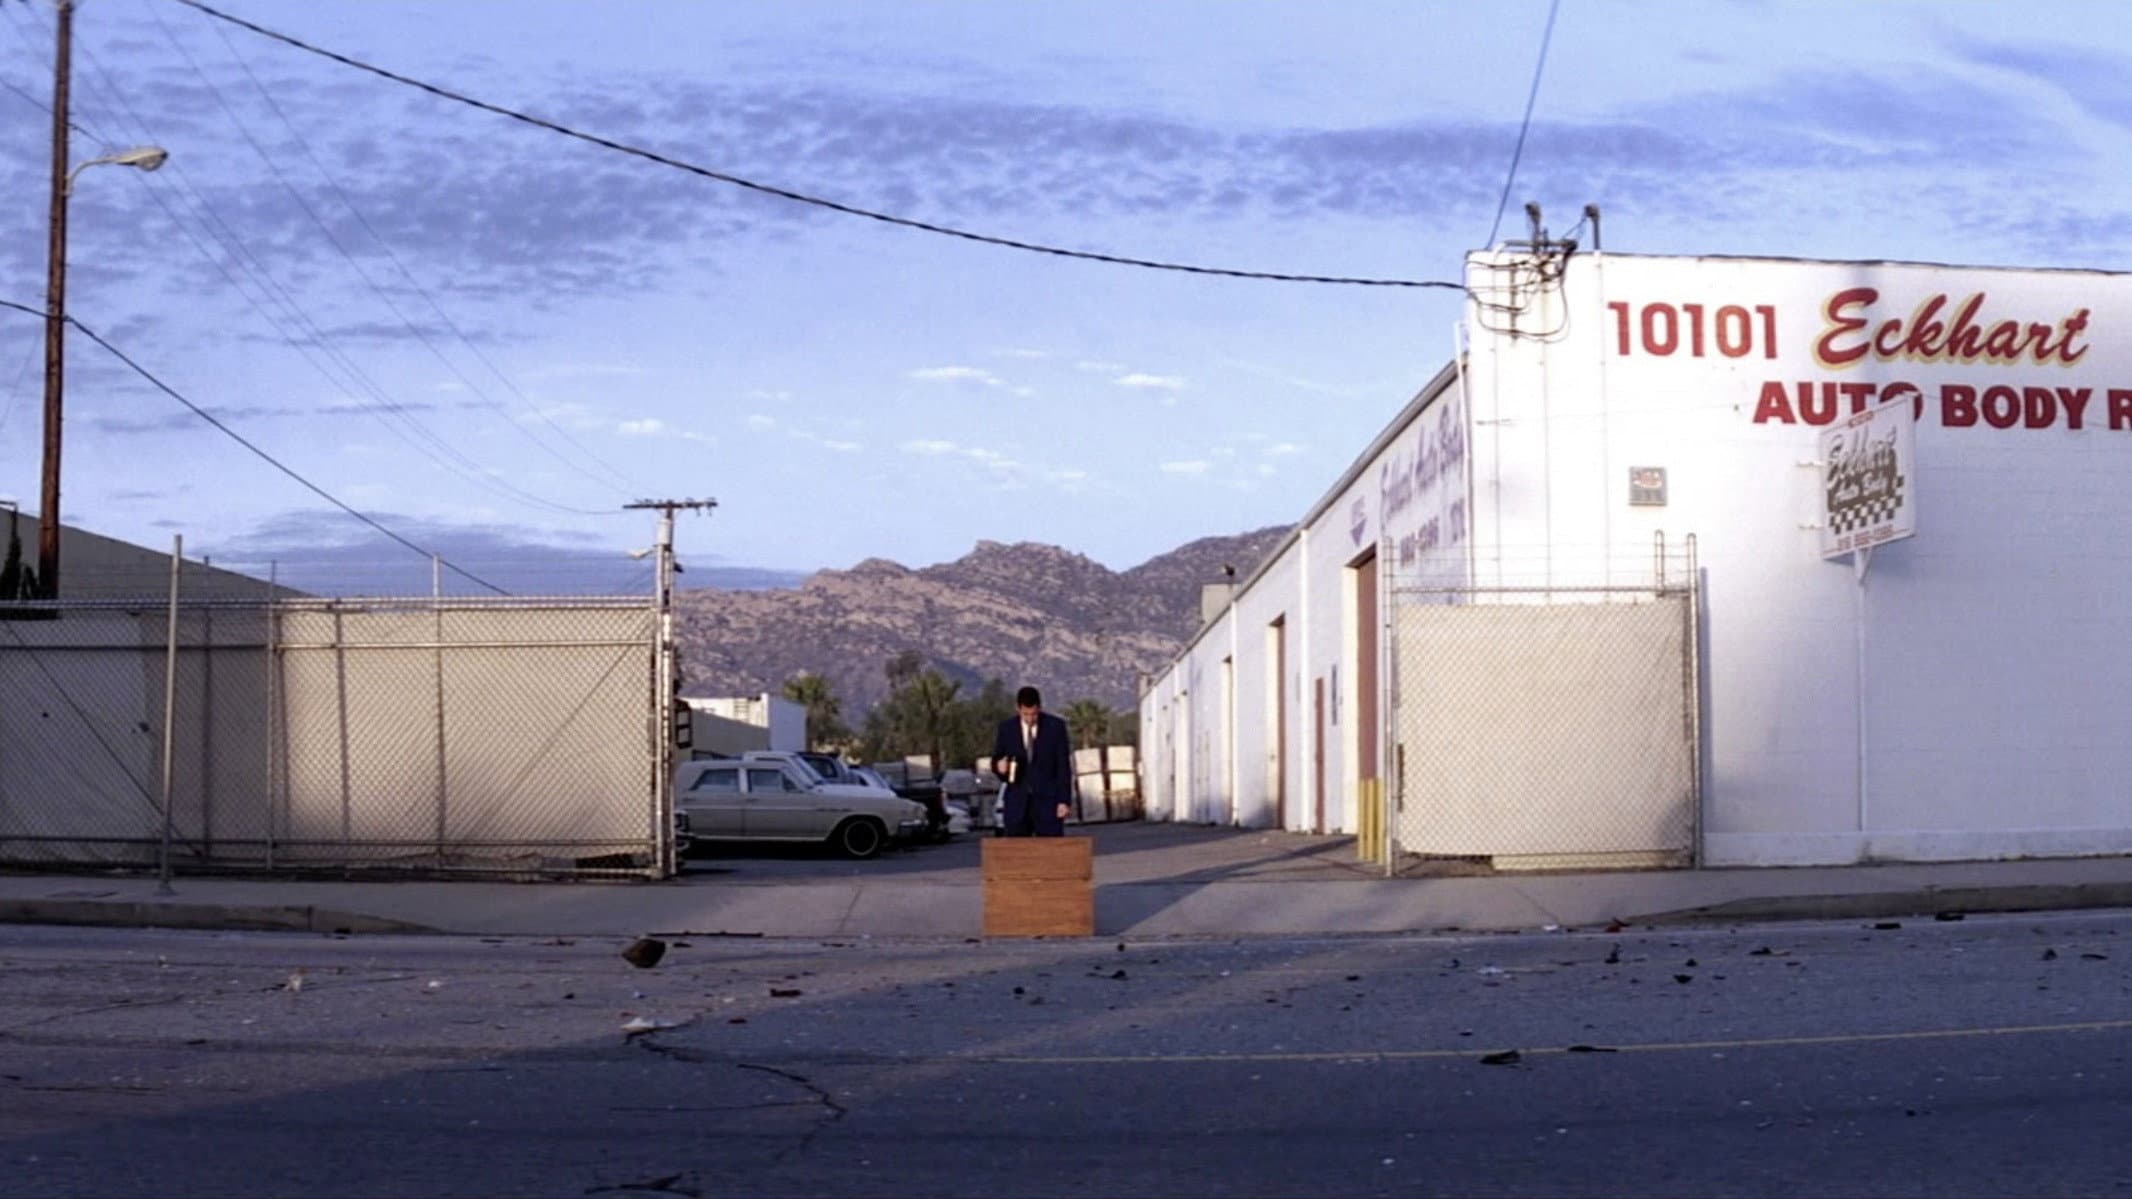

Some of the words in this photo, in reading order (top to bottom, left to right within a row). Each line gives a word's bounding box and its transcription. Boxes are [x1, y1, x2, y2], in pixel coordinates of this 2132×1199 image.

[1607, 301, 1778, 359] 10101
[1812, 287, 2091, 368] Eckhart
[1940, 384, 2093, 430] BODY
